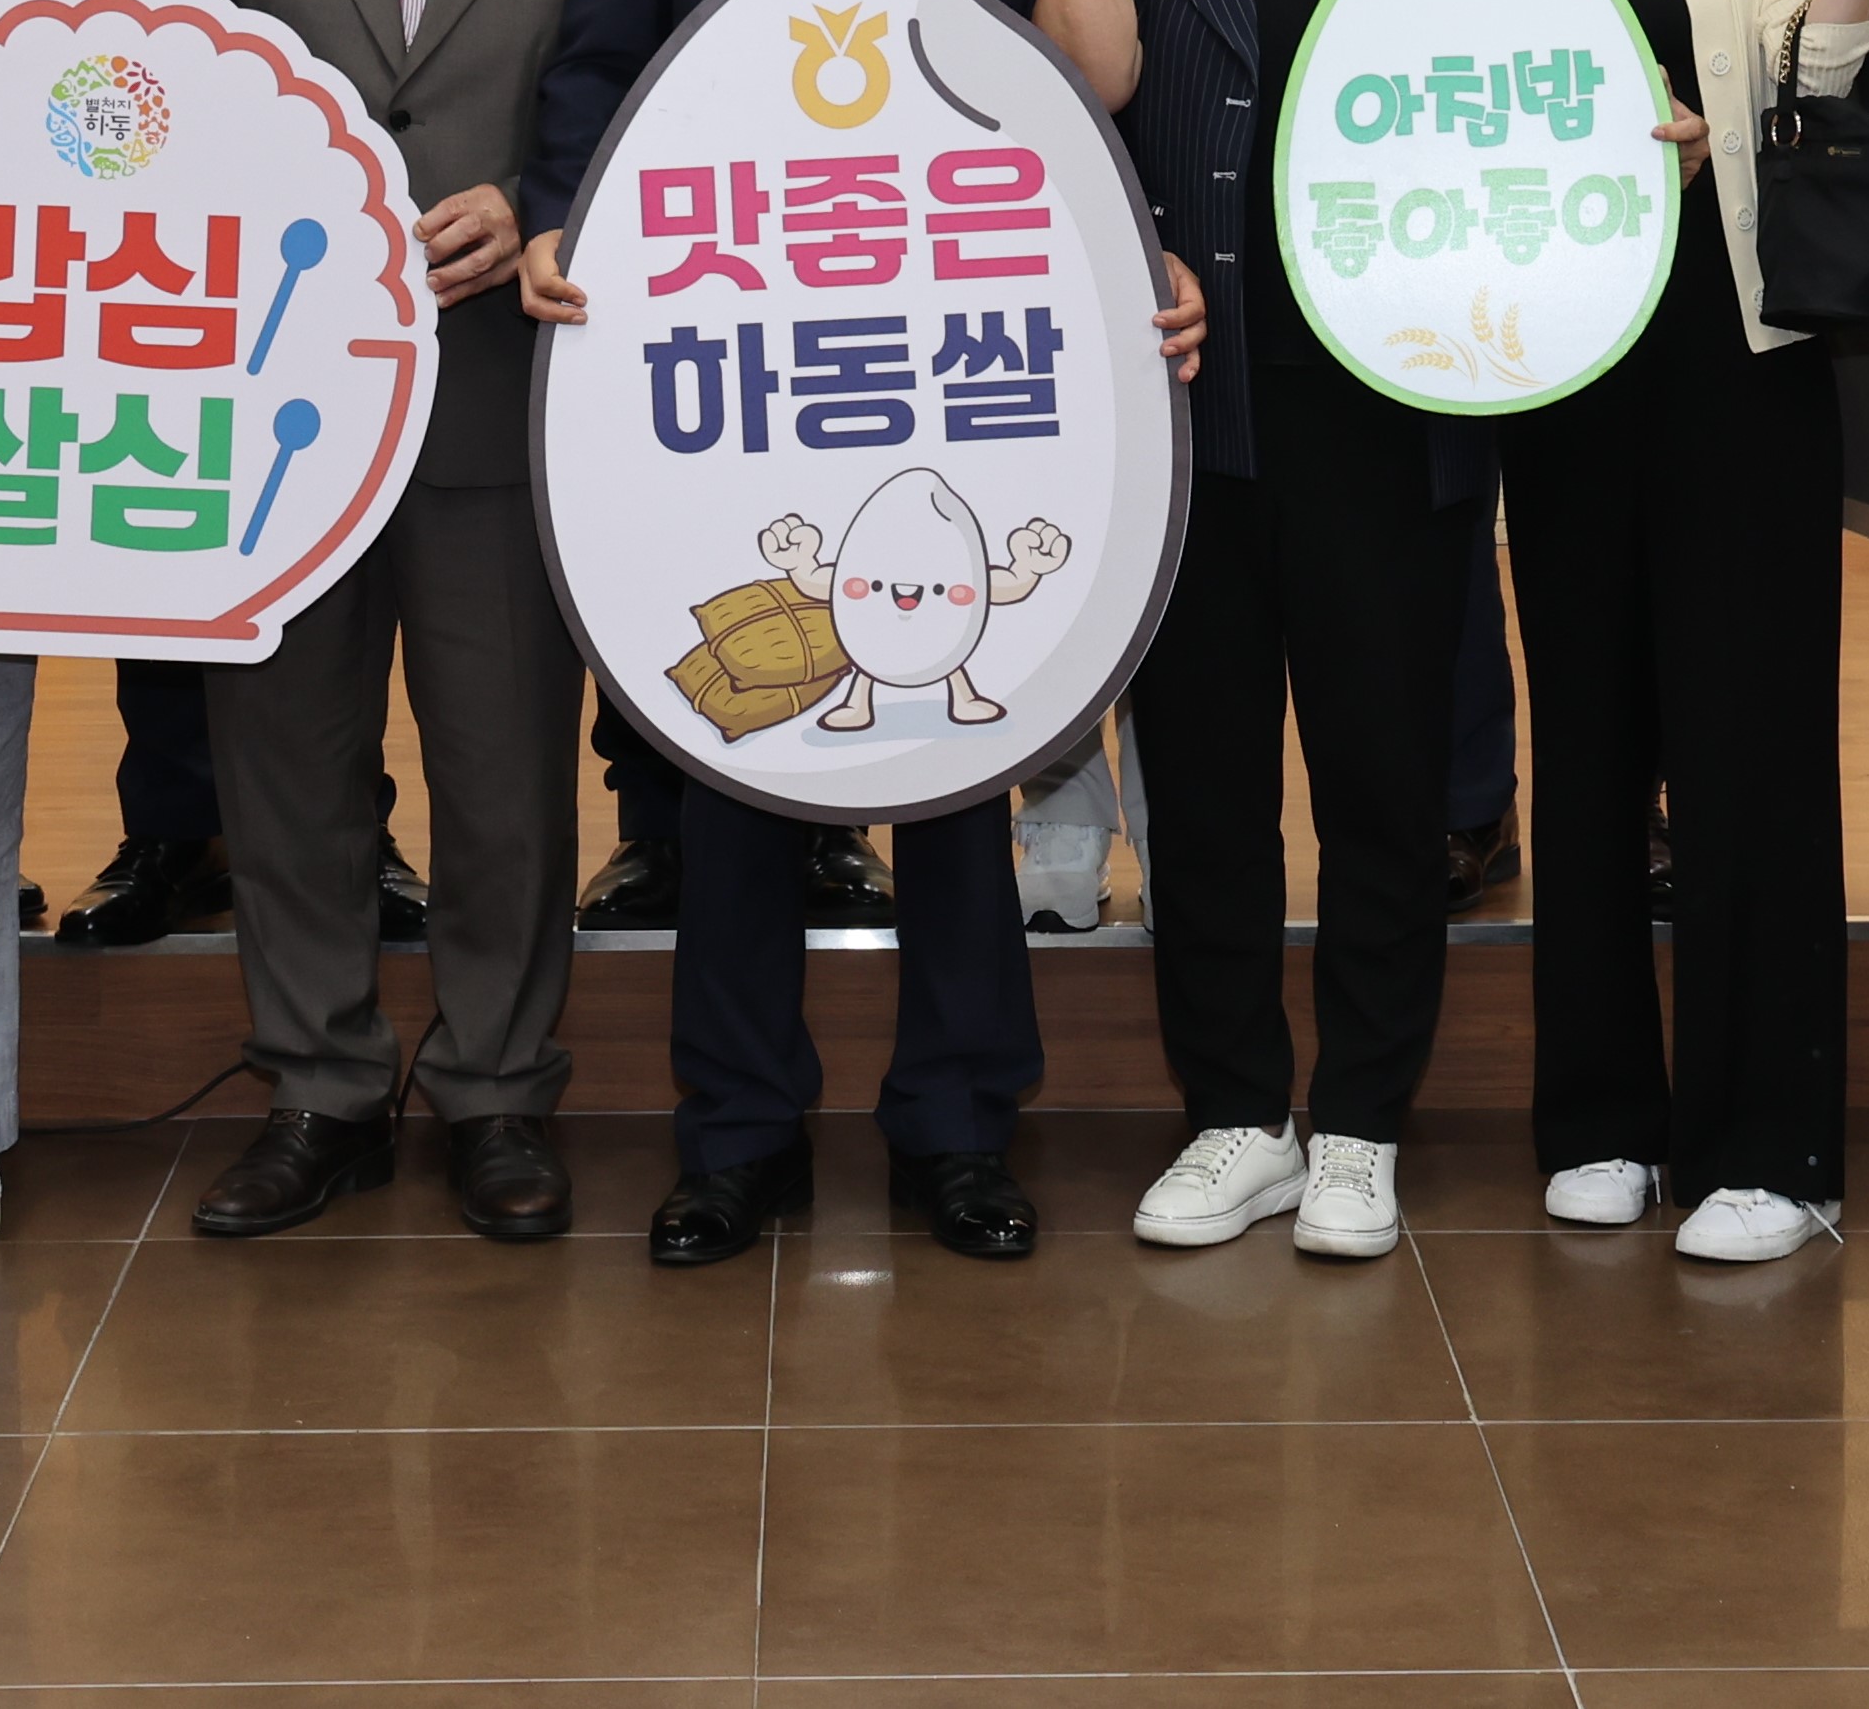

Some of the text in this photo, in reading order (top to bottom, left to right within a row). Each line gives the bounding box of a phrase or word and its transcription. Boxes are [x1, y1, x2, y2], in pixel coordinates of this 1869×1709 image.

[83, 113, 132, 141] 하동
[85, 96, 131, 114] 별천지
[1334, 48, 1606, 148] 아침밥
[639, 147, 1052, 297] 맛좋은
[1308, 168, 1653, 280] 좋아좋아
[643, 306, 1065, 455] 하동쌀
